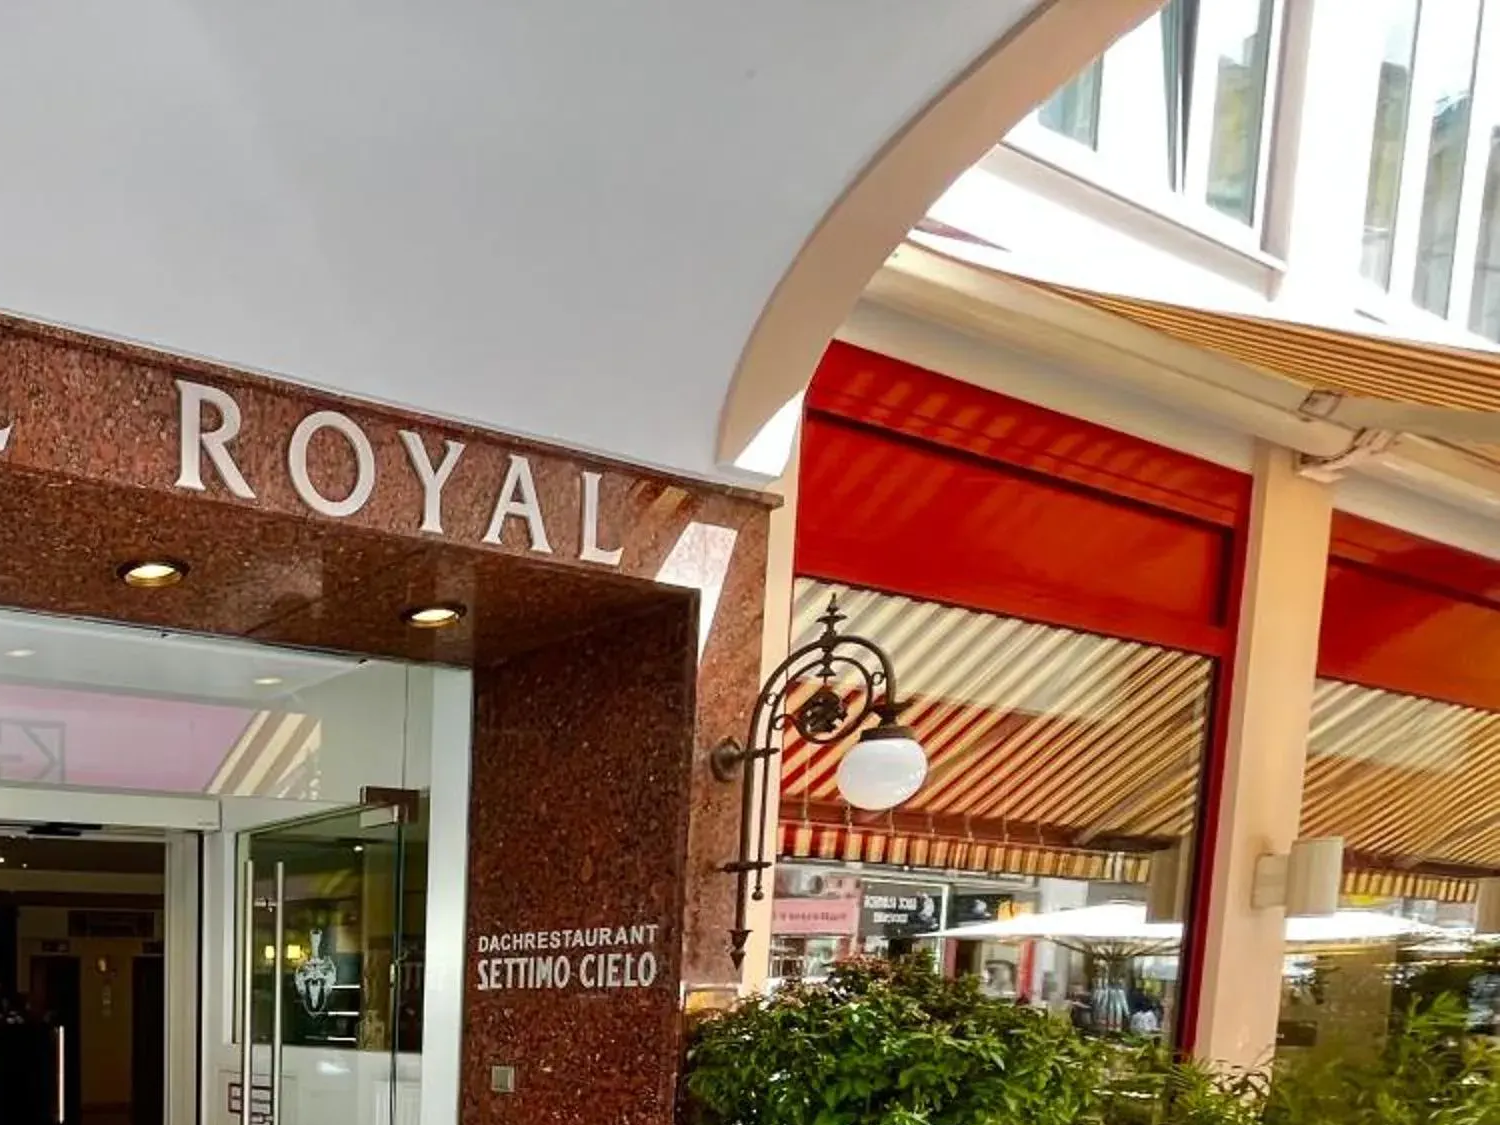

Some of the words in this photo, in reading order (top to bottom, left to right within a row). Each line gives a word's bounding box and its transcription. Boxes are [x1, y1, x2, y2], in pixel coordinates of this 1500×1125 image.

[174, 379, 624, 566] ROYAL
[478, 924, 659, 953] DACHRESTAURANT
[477, 955, 571, 991] SETTIMO
[579, 951, 658, 989] CIELO
